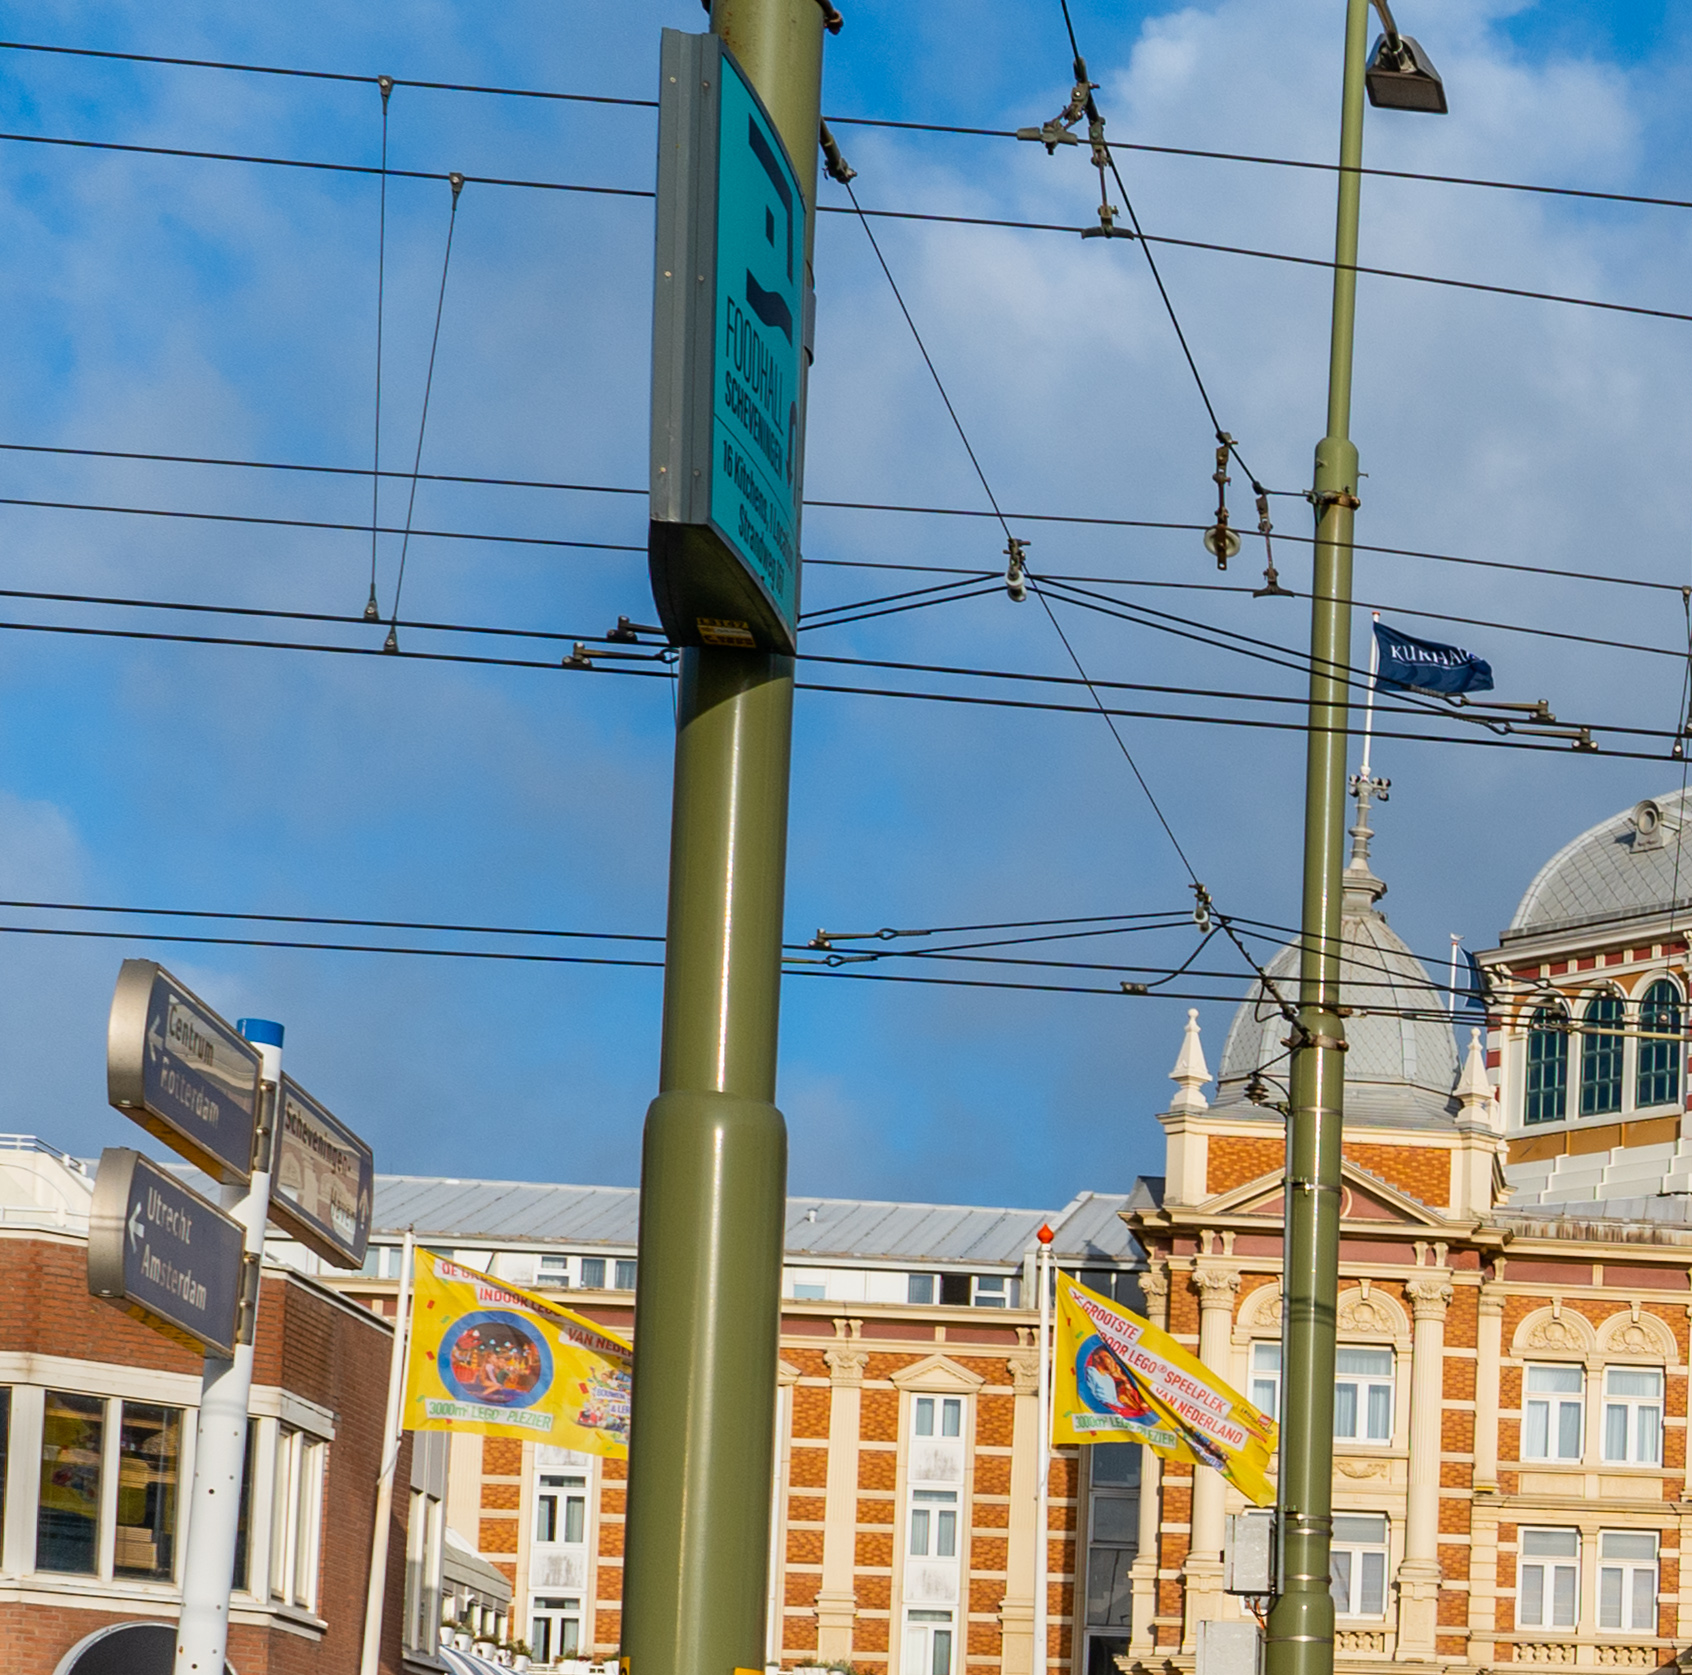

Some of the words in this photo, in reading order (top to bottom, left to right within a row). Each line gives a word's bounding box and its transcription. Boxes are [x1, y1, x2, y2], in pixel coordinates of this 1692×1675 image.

[726, 295, 783, 437] FOODHALL
[724, 369, 783, 481] SCHEVENINGEN
[723, 439, 733, 478] 16
[168, 1004, 214, 1067] Centrum
[160, 1056, 219, 1128] Rotterdam
[284, 1101, 352, 1176] Scheveningen-
[146, 1185, 193, 1245] Utrecht
[140, 1245, 207, 1311] Amsterdam
[568, 1327, 593, 1348] VAN
[1081, 1300, 1139, 1341] GROOTSTE
[507, 1408, 551, 1429] PLEZIER
[1164, 1370, 1227, 1414] SPEELPLEK
[1176, 1402, 1244, 1444] NEDERLAND
